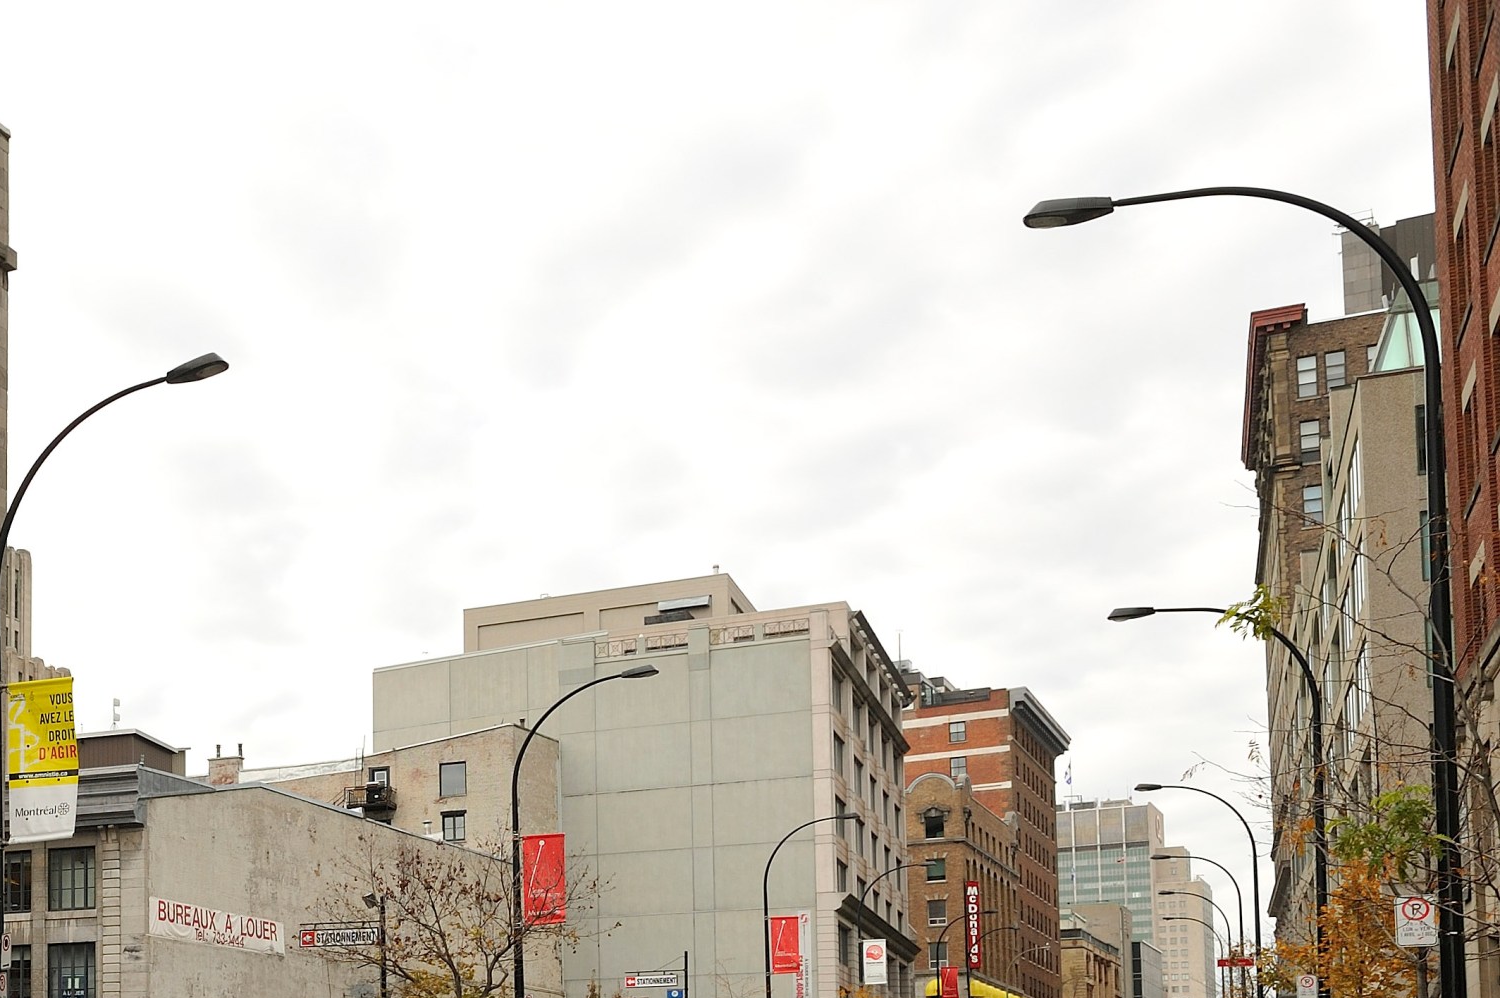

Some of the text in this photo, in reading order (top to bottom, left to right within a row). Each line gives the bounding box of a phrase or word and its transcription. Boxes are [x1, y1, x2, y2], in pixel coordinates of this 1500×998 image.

[49, 692, 73, 705] VOUS
[40, 710, 74, 725] AVEZ LE
[49, 728, 75, 742] DROIT
[39, 744, 77, 760] D'AGIR
[15, 805, 57, 818] Montréal
[158, 900, 216, 931] BUREAUX
[240, 916, 278, 941] LOUER
[967, 886, 979, 963] McDonald's
[316, 930, 376, 944] STATIONNEMENT
[637, 977, 676, 985] STATIONNEMENT
